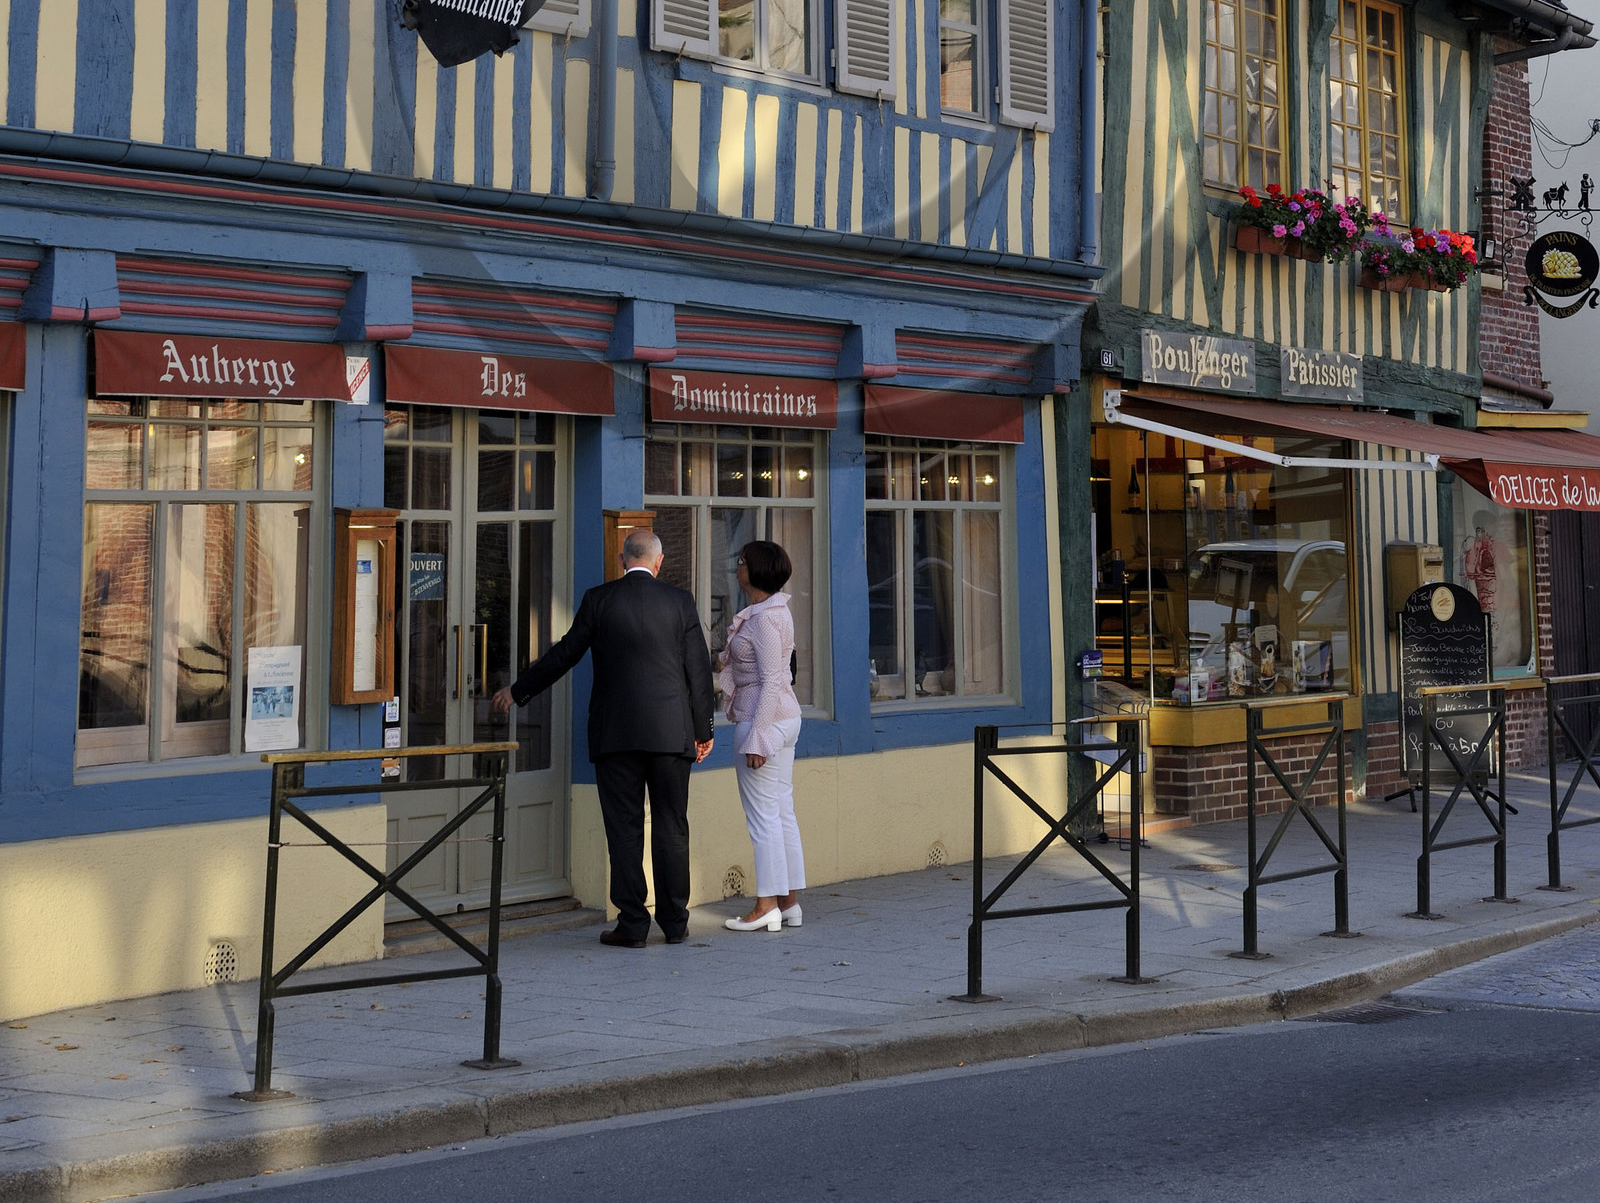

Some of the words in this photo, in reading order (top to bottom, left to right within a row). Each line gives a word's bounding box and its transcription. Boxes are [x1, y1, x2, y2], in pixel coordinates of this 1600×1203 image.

[1545, 232, 1578, 246] PAINS
[160, 339, 296, 396] Auberge
[480, 356, 527, 399] Des
[1102, 351, 1113, 365] 61
[1150, 334, 1249, 389] Boulanger
[1287, 348, 1358, 389] Pâtissier
[671, 374, 818, 418] Dominicaines
[1498, 473, 1559, 507] DELICES
[1562, 474, 1582, 506] de
